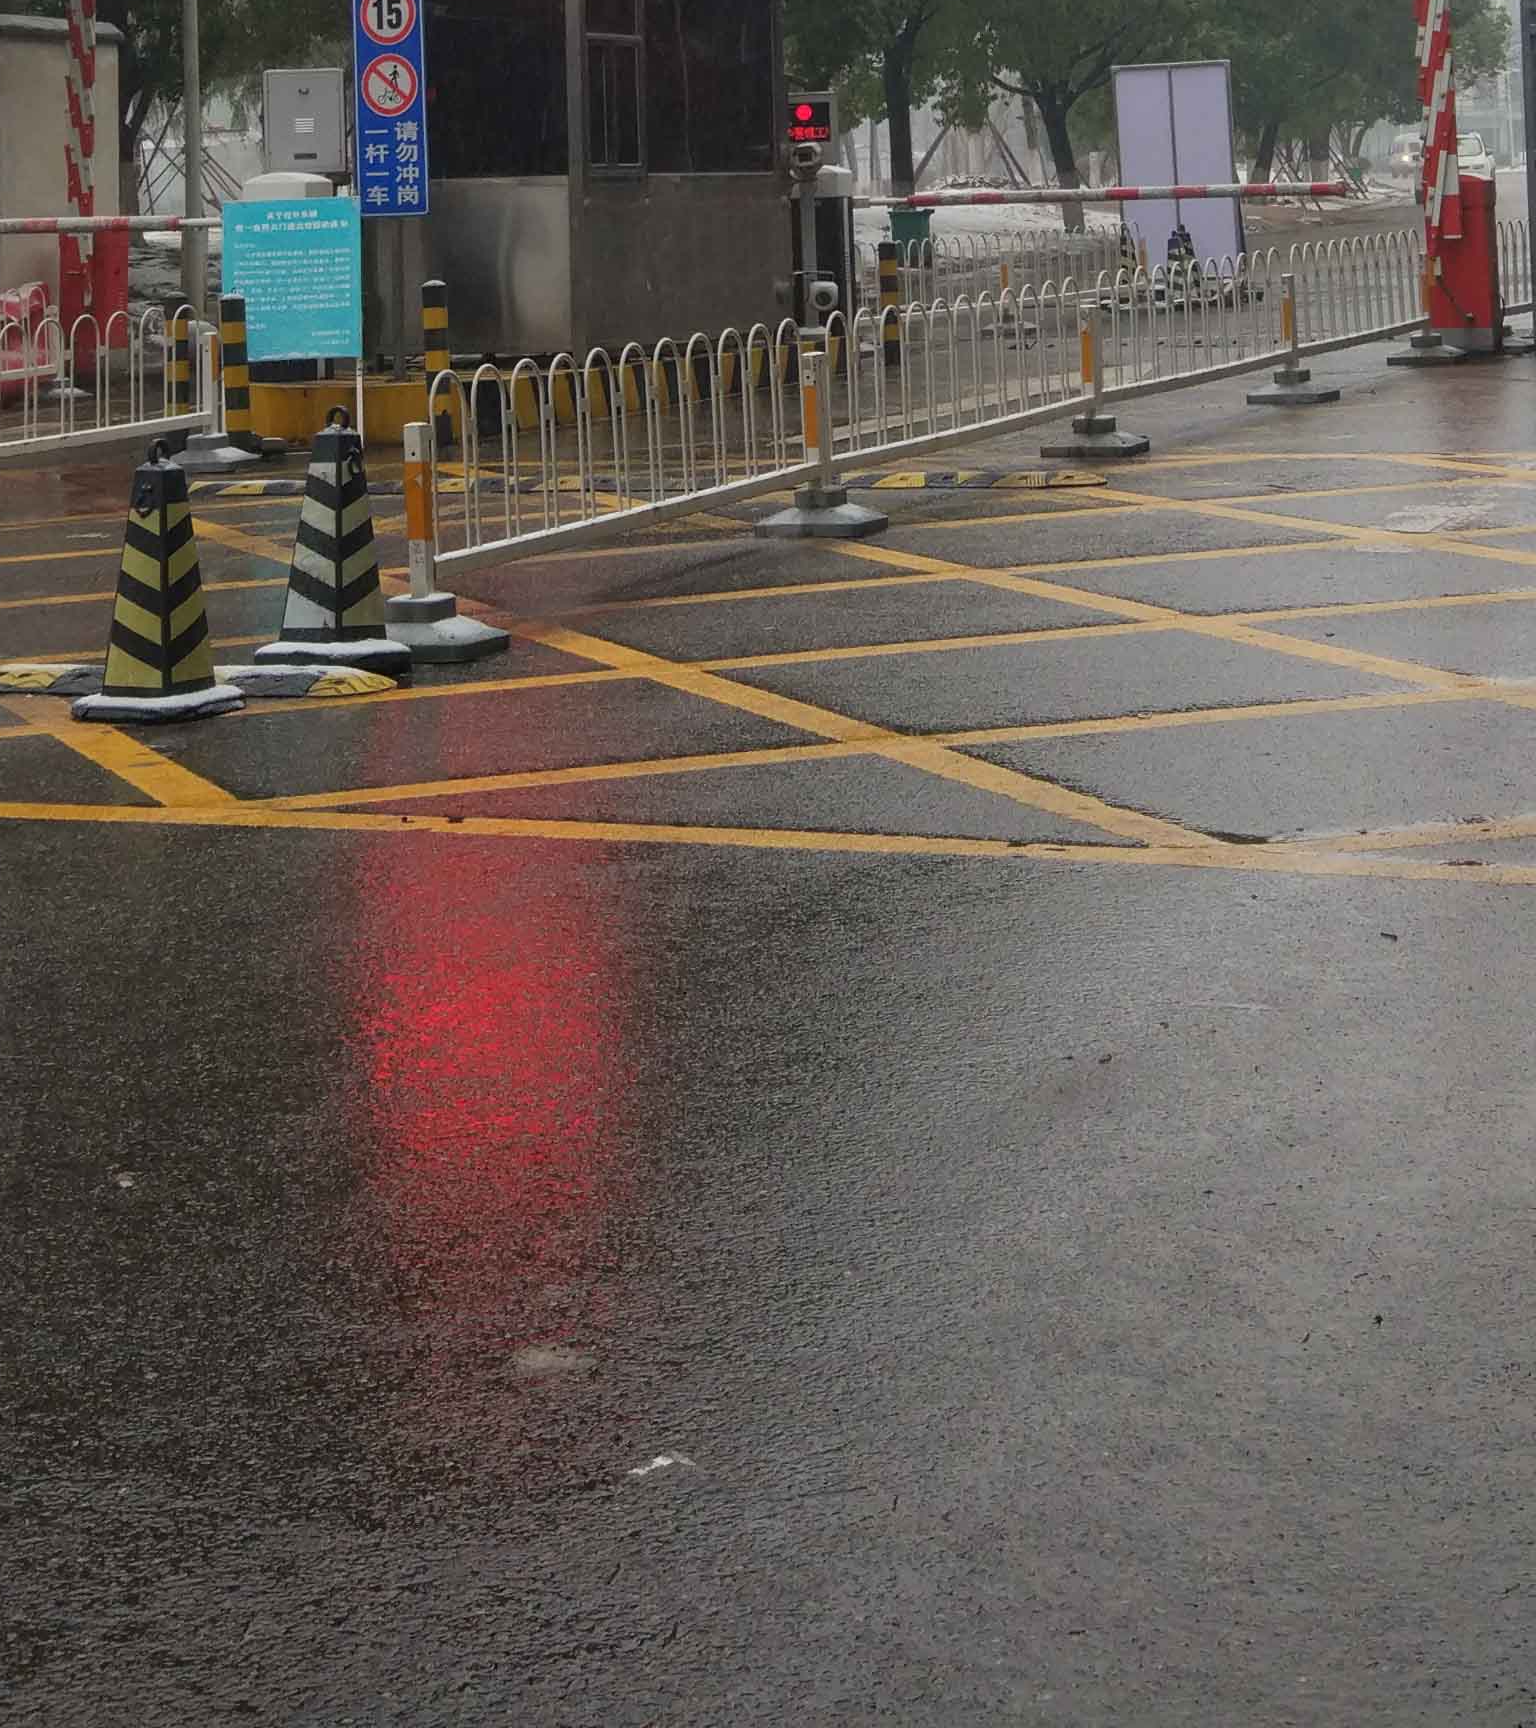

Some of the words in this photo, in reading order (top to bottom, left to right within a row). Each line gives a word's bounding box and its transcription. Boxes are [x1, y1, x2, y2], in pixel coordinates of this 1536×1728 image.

[365, 129, 390, 206] 一杆一车
[395, 120, 420, 206] 请勿冲岗
